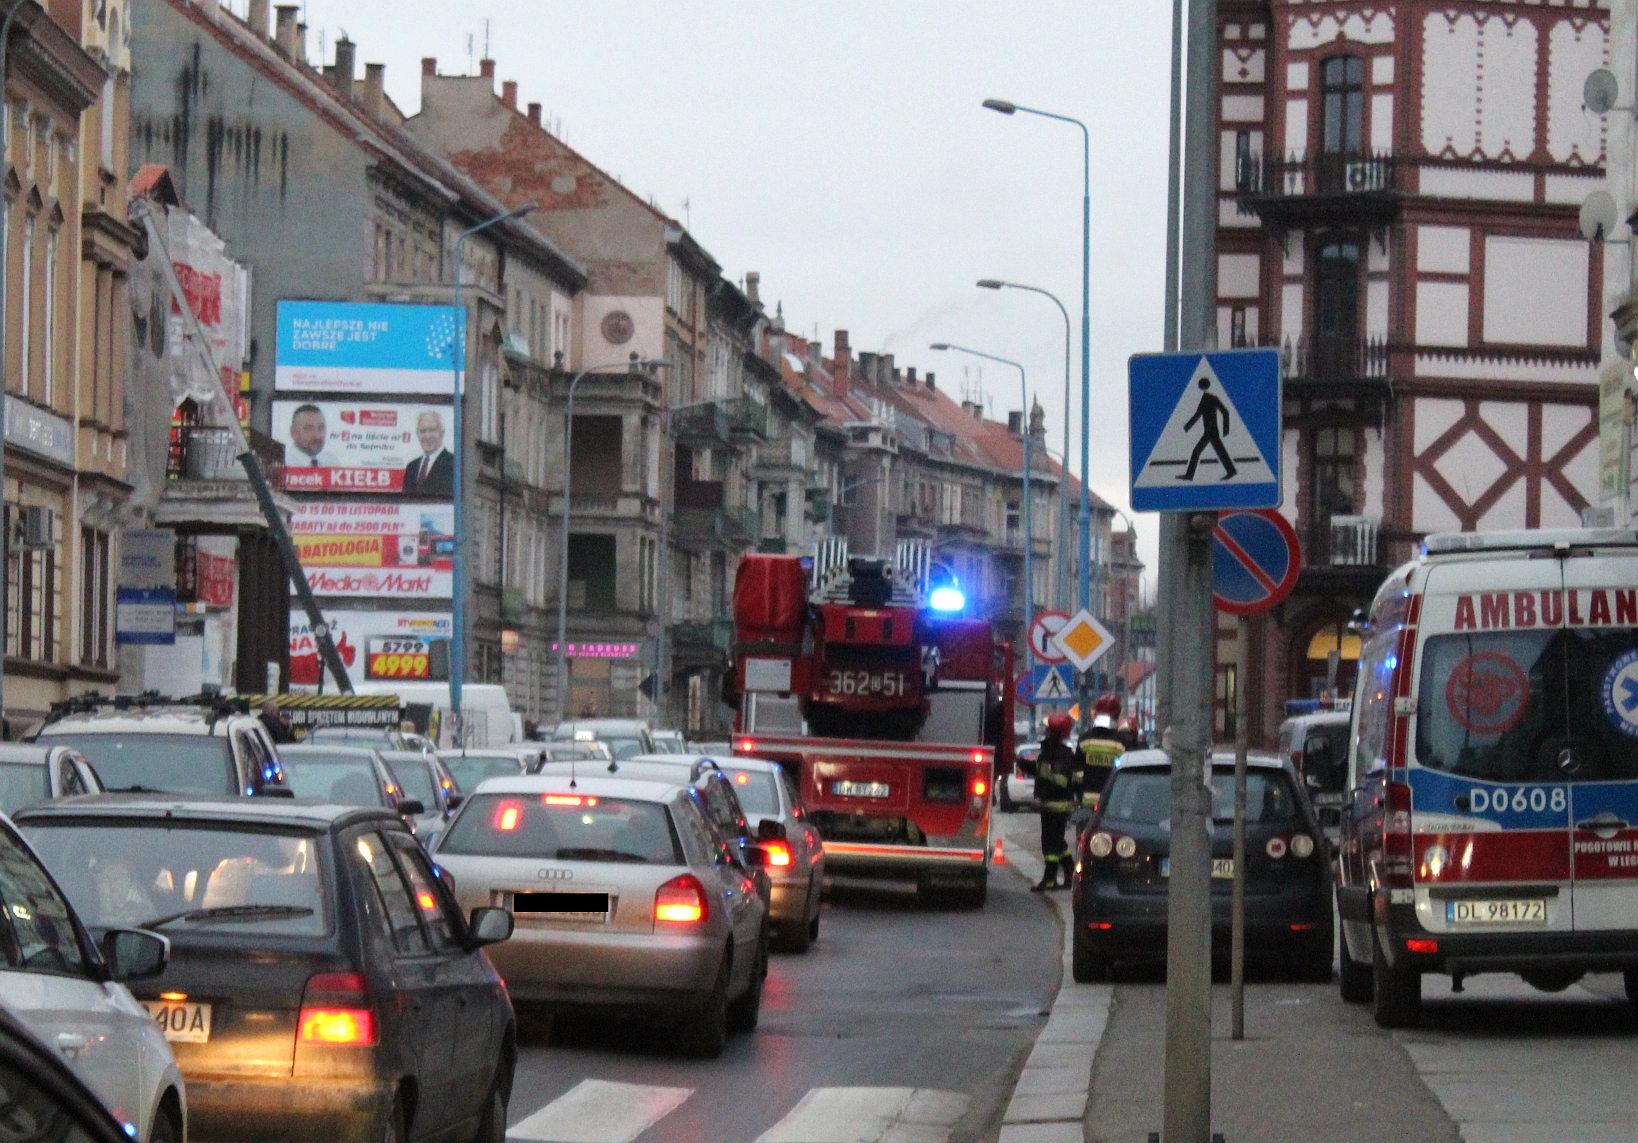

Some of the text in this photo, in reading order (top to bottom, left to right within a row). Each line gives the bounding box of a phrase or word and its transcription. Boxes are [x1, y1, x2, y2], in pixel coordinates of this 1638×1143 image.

[293, 318, 389, 332] NAJLEPSZE NIE
[293, 329, 377, 342] ZAWSZE JEST
[330, 470, 391, 487] KIEŁB
[349, 504, 400, 515] LISTOPADA
[353, 522, 380, 532] 2500
[376, 573, 433, 592] Markt
[1454, 589, 1638, 631] AMBULAN
[382, 641, 424, 654] 5799
[372, 655, 428, 677] 4999
[1470, 787, 1566, 814] D0608
[1574, 841, 1631, 853] POGOTOWIE
[1608, 855, 1619, 867] W
[1458, 903, 1543, 920] DL 98172
